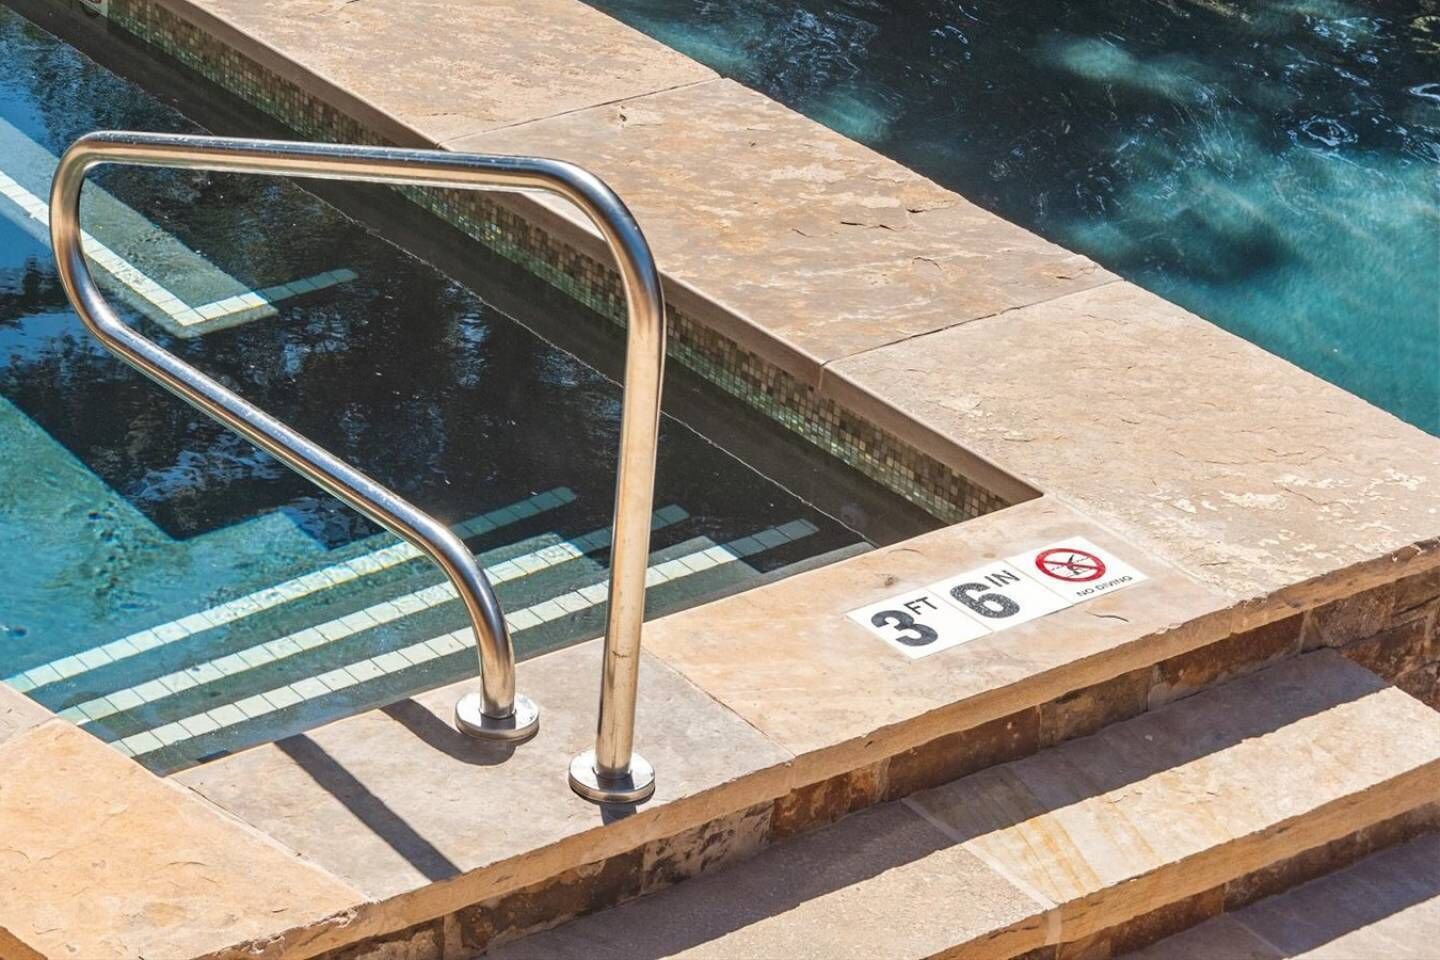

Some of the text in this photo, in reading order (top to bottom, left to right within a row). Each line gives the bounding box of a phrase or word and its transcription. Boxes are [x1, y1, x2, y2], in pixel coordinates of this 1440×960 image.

[870, 568, 1021, 648] 3 FT 6 IN
[1076, 575, 1133, 597] NO DIVING
